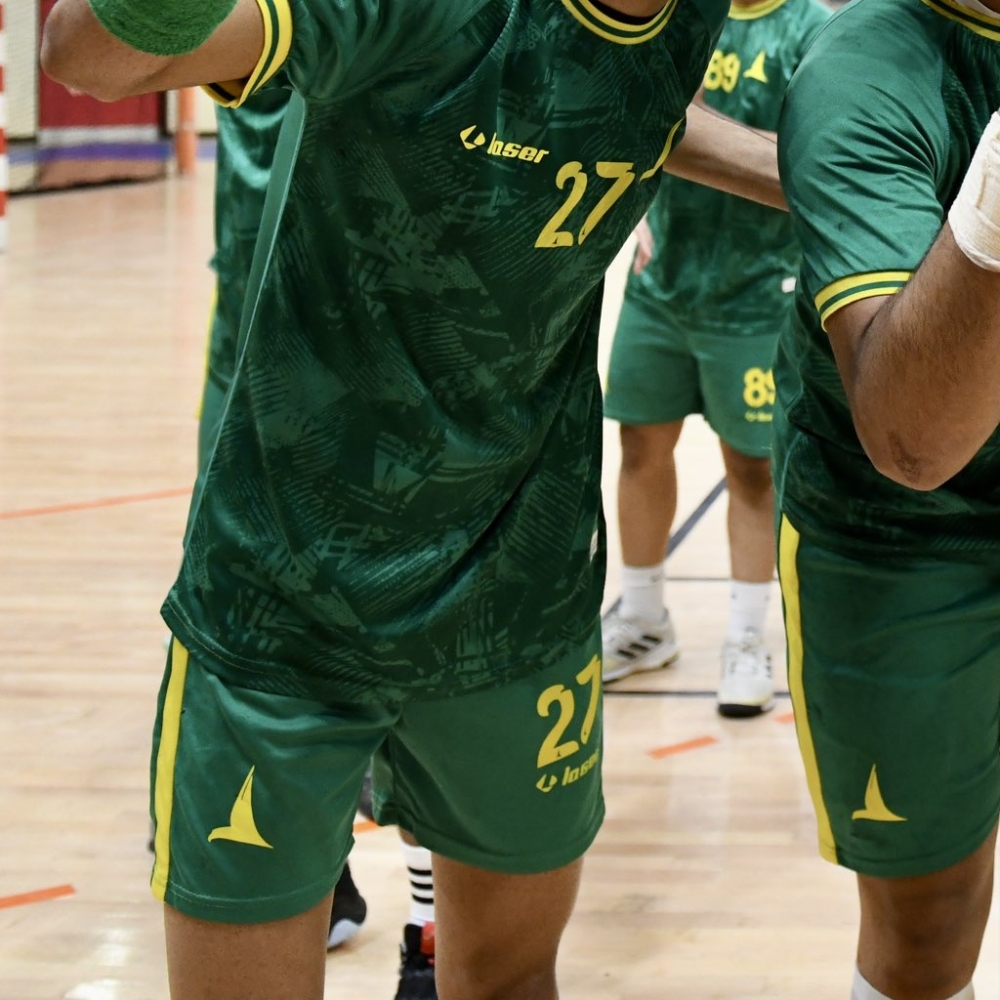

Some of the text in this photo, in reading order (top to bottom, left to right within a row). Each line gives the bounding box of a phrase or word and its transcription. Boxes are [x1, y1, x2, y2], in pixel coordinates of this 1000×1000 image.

[704, 49, 741, 94] 89
[487, 132, 550, 164] laser
[534, 160, 636, 248] 27
[536, 653, 601, 769] 27
